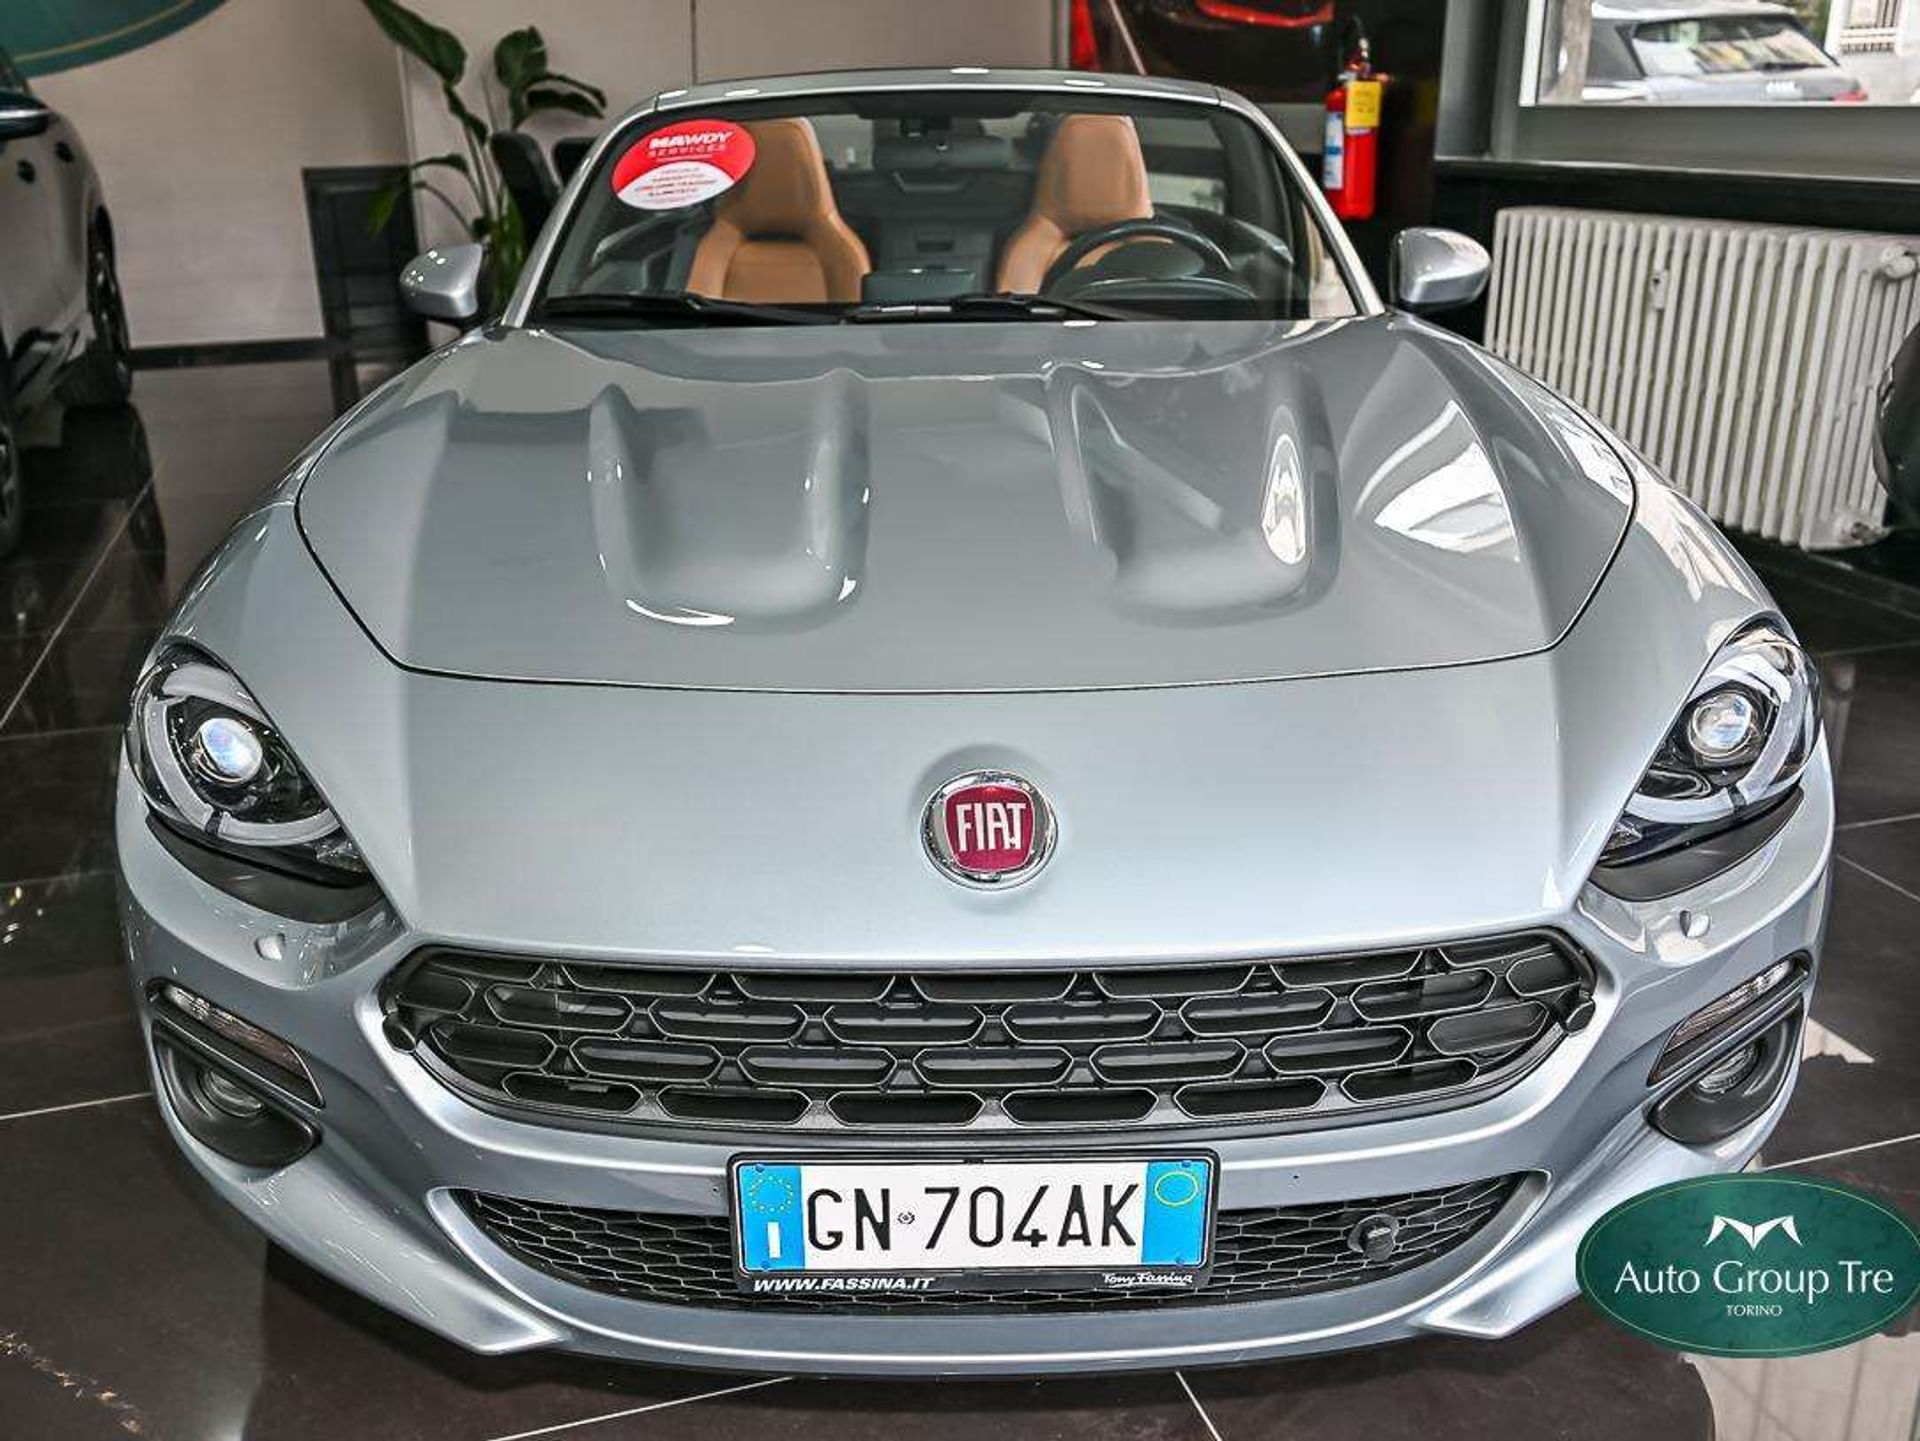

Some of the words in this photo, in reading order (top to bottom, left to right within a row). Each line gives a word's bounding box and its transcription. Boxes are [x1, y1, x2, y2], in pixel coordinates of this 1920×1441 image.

[649, 131, 734, 149] MAWDY
[955, 802, 1026, 852] FIAT
[807, 1187, 891, 1251] GN
[924, 1181, 1140, 1250] 704AK
[753, 1277, 935, 1292] WWW.FASSINA.IT
[1102, 1272, 1136, 1287] Tony
